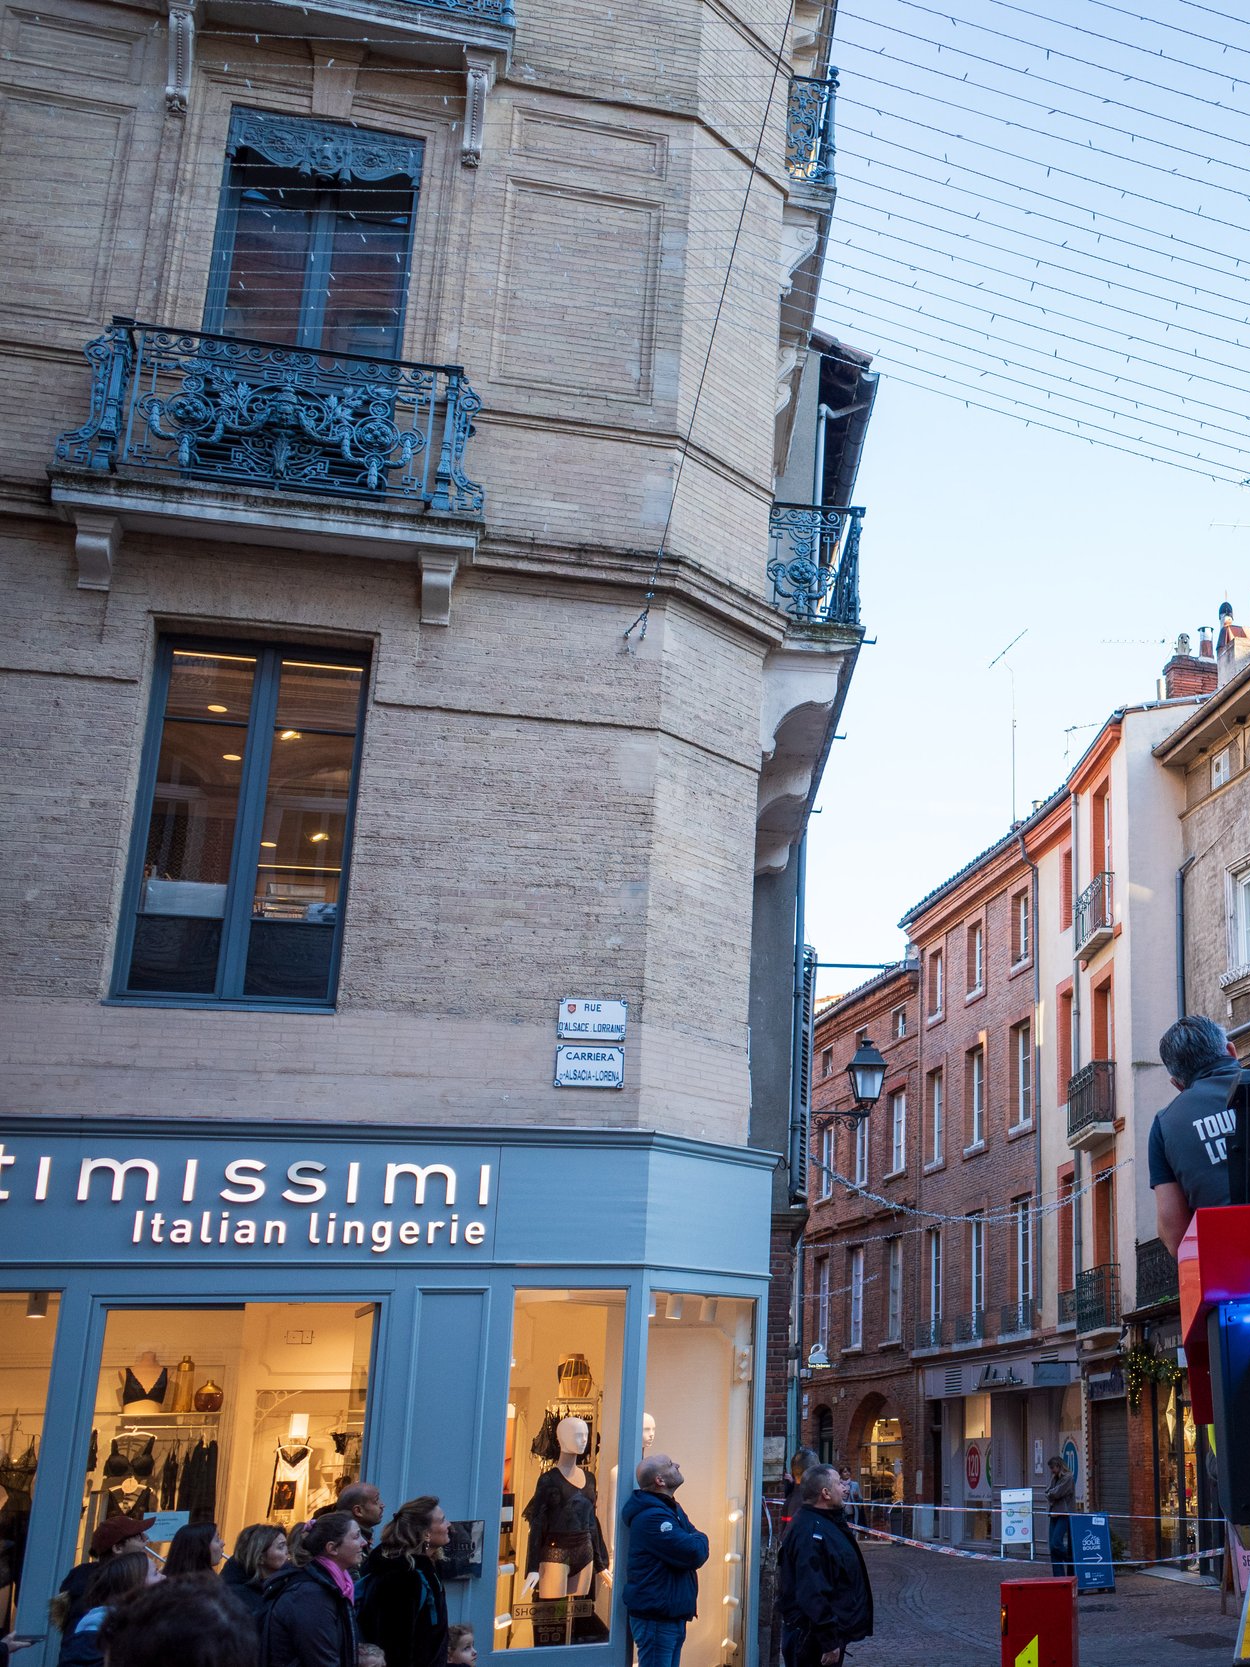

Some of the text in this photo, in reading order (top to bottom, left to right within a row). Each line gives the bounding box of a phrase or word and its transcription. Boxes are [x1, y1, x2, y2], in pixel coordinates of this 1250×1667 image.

[584, 1003, 602, 1012] RUE
[132, 1210, 486, 1253] Italian lingerie
[515, 1606, 544, 1617] SHO
